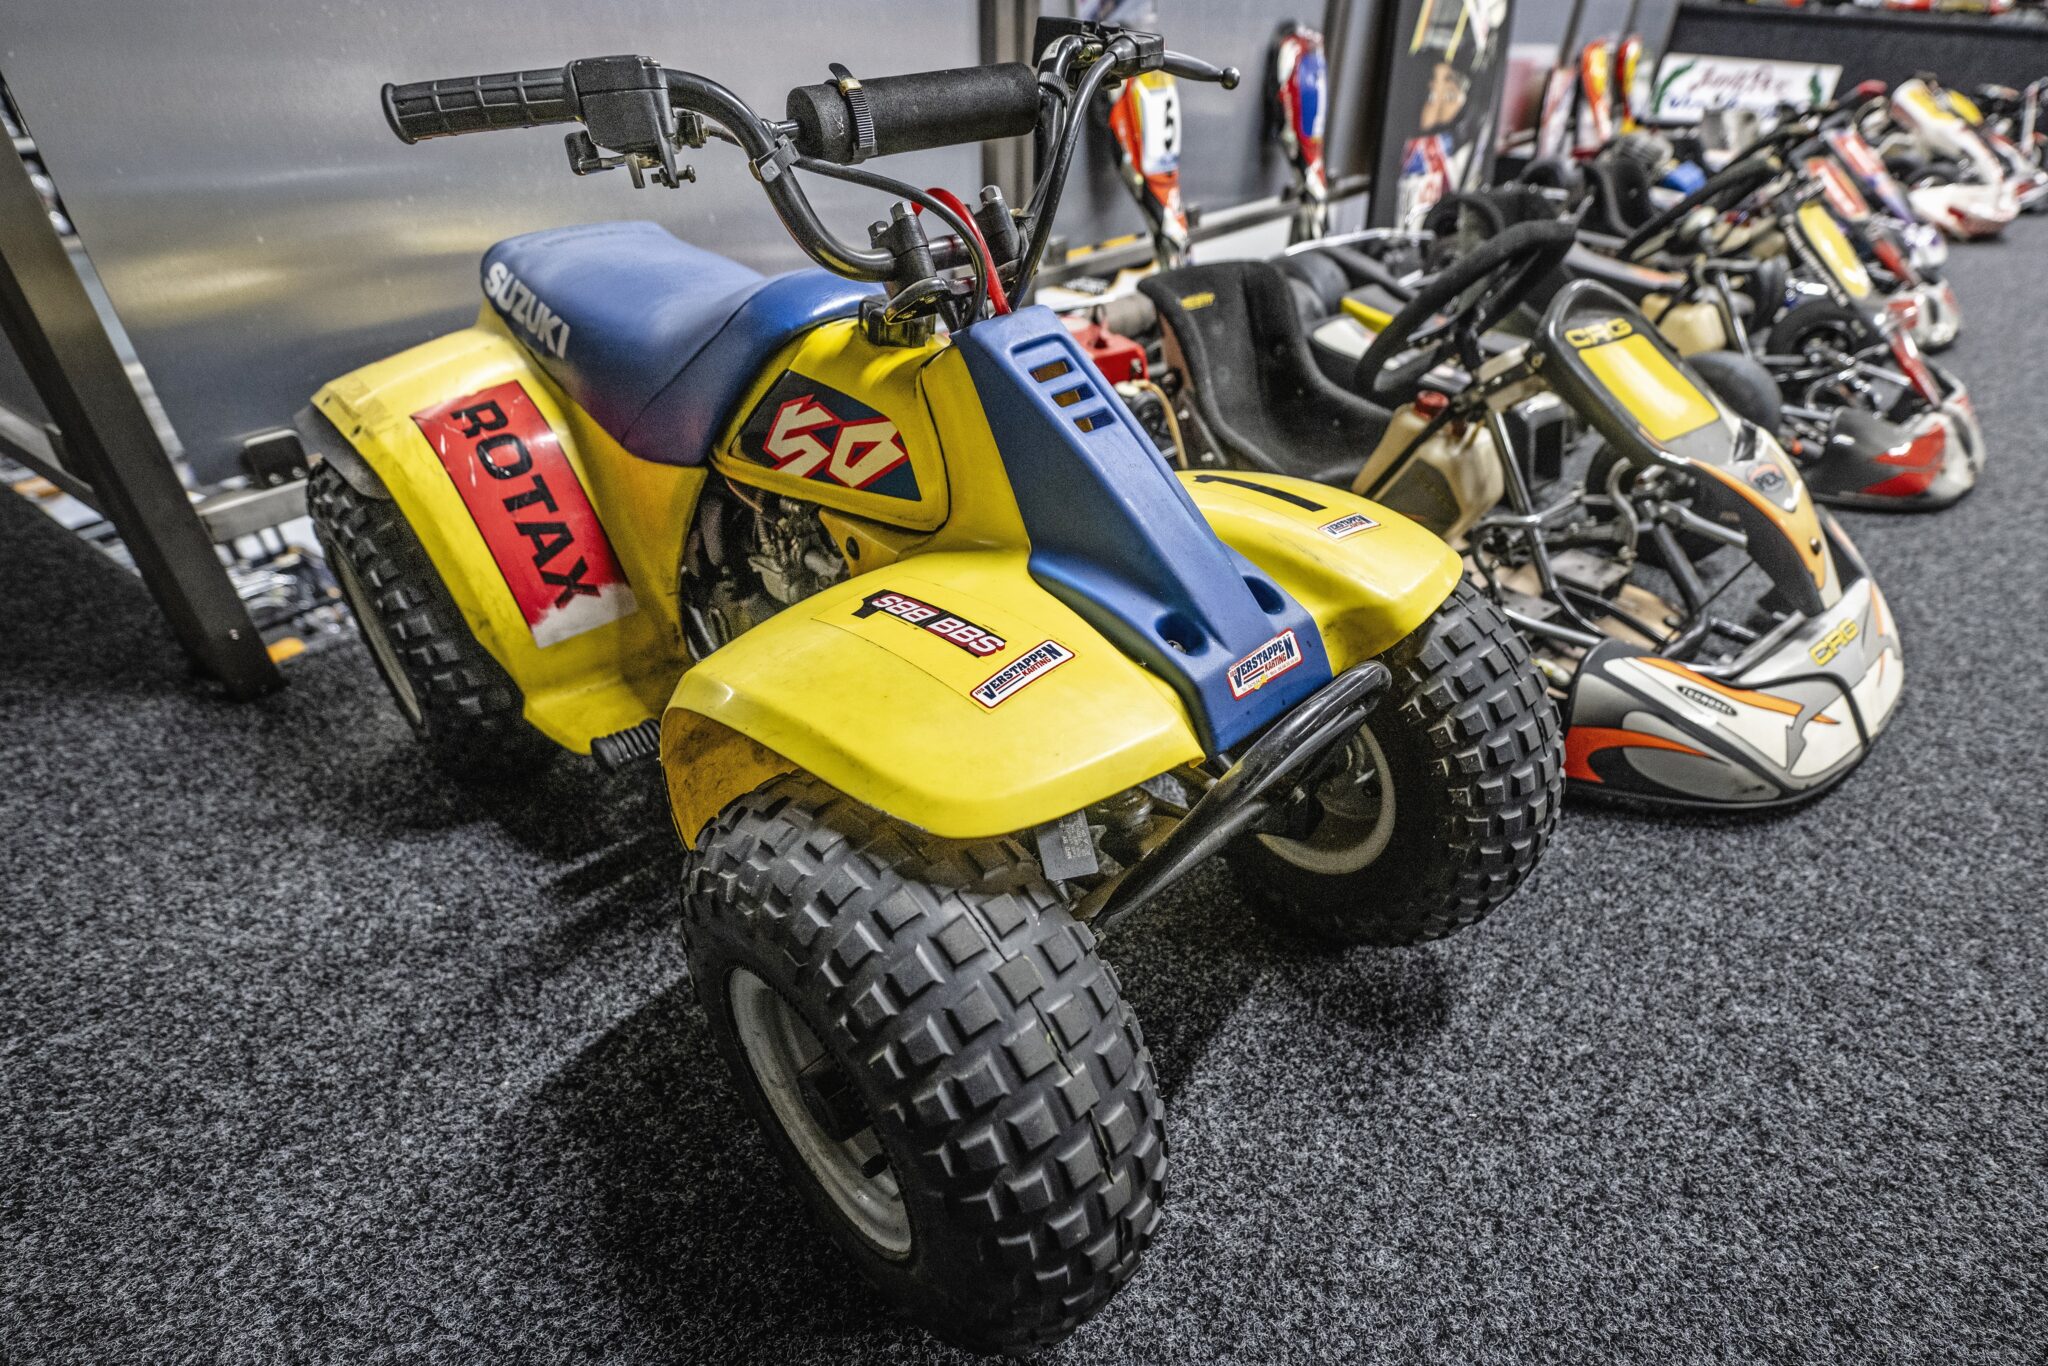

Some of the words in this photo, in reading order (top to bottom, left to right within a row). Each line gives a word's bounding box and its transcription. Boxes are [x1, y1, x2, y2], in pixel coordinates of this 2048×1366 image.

[484, 261, 571, 359] SUZUKI
[1564, 317, 1633, 348] CRG
[451, 400, 602, 610] ROTAX
[1194, 474, 1328, 512] 1
[926, 617, 1005, 656] BBS
[1809, 617, 1860, 667] CRG
[983, 643, 1063, 700] VERSTAPPEN
[1021, 656, 1052, 677] KARTING
[1234, 635, 1295, 688] VERSTAPPEN
[1264, 652, 1287, 672] KARTING
